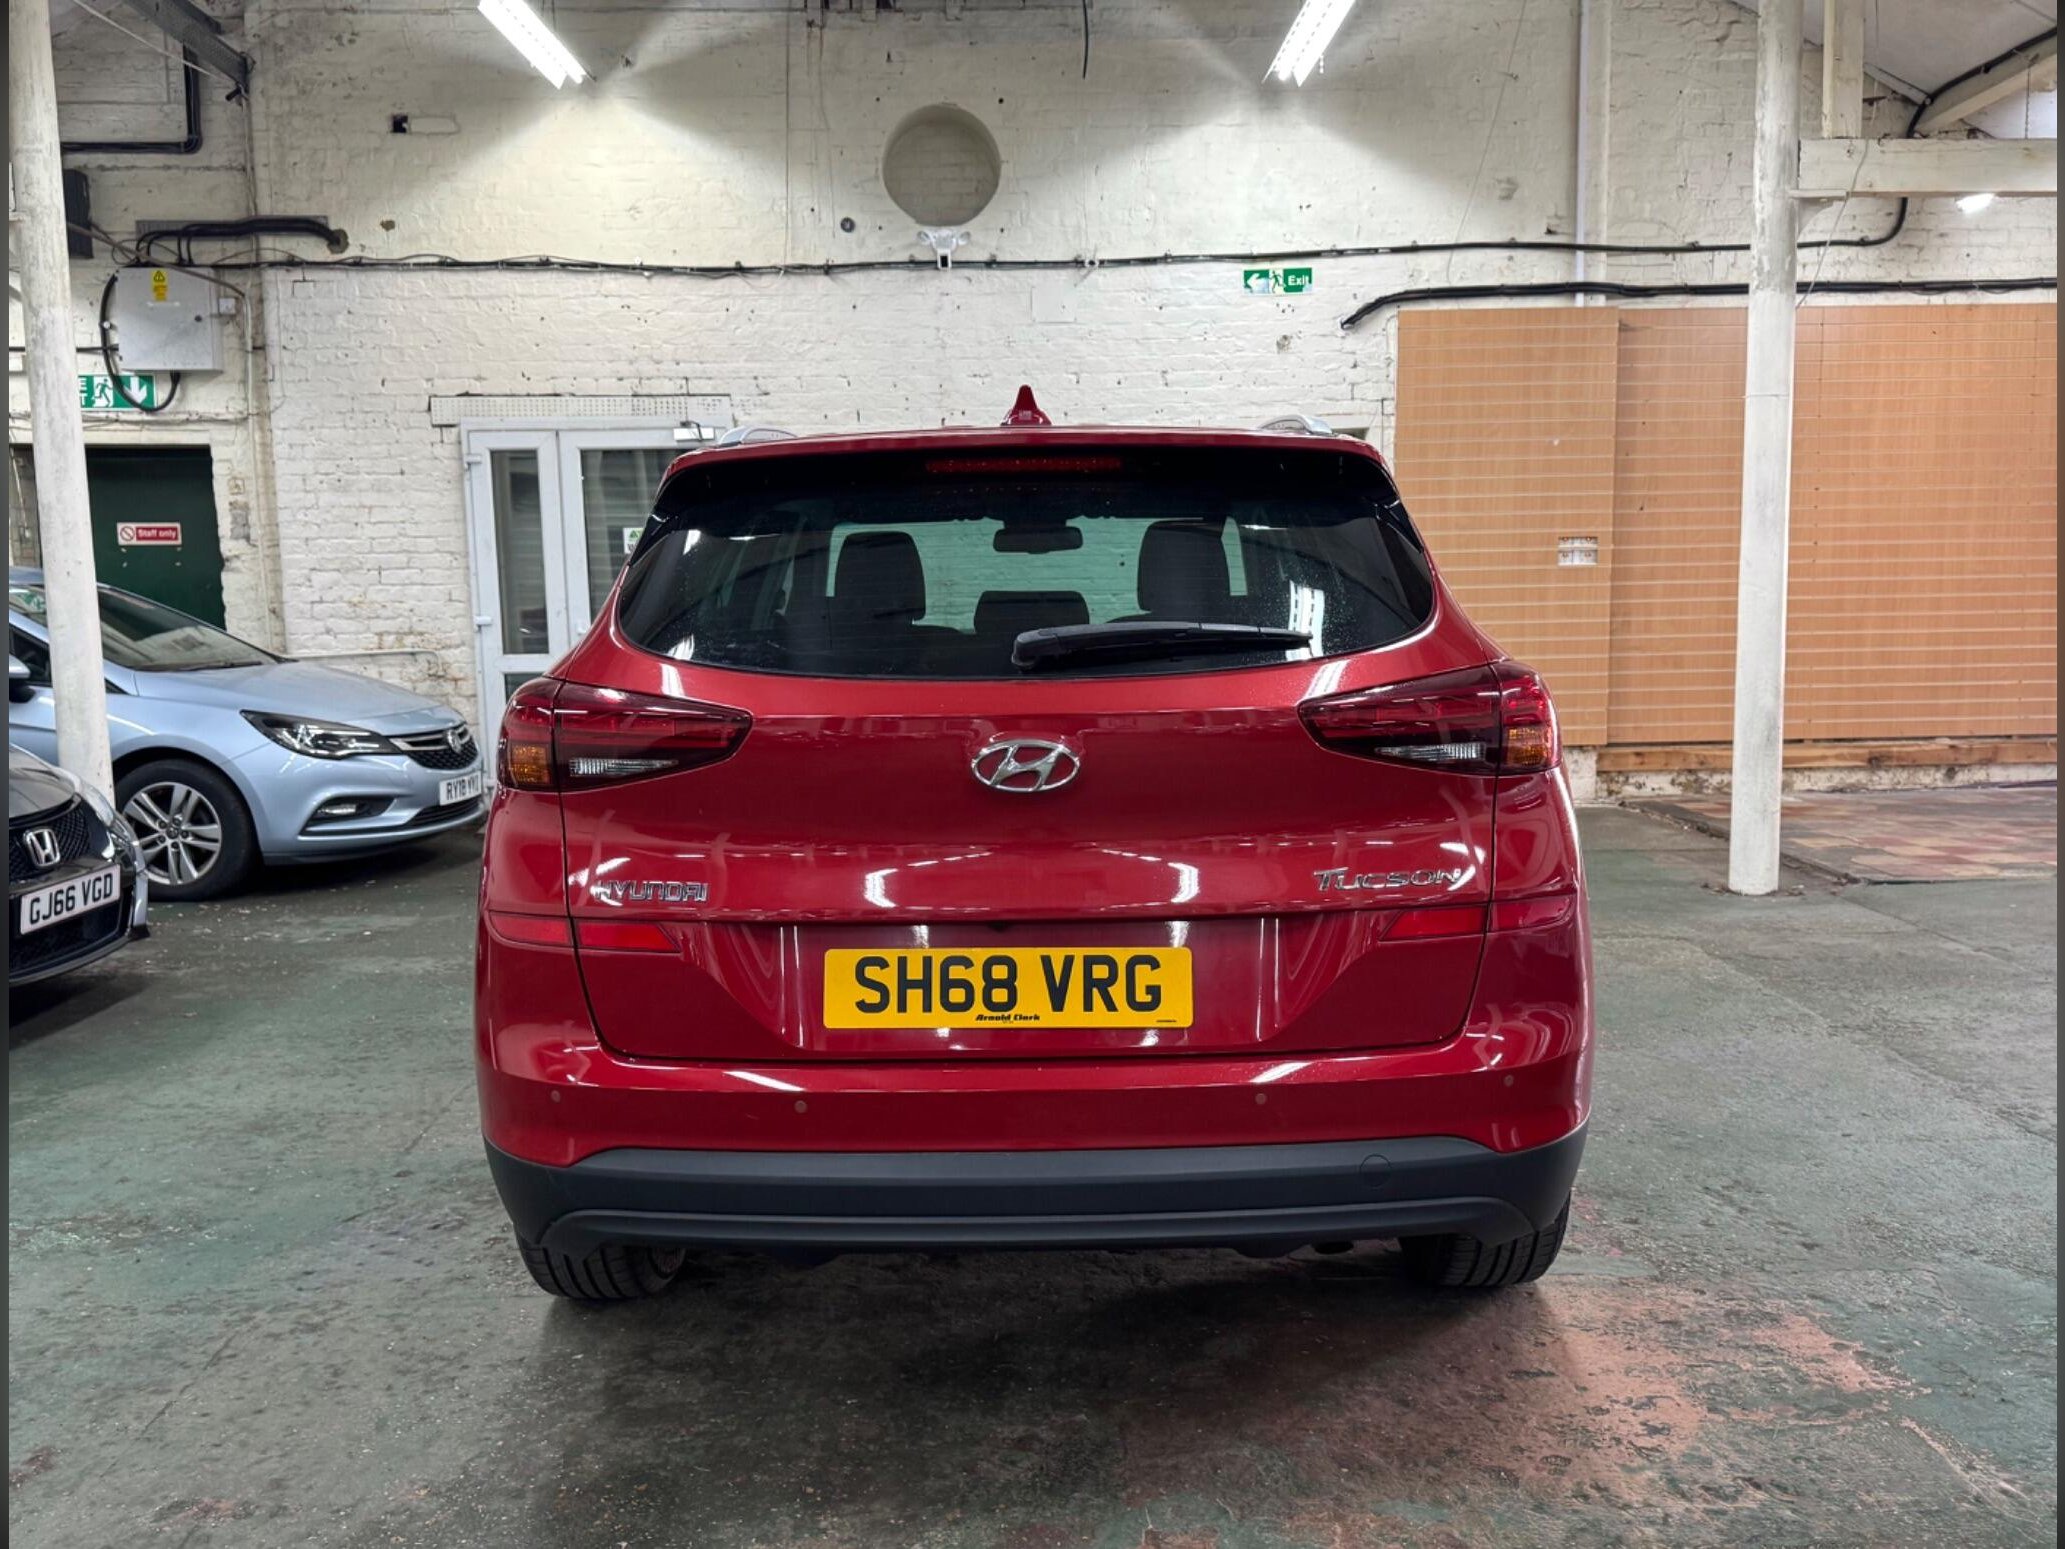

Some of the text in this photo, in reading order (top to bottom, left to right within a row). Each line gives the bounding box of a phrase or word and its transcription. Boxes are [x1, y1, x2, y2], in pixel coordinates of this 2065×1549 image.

[1287, 274, 1309, 286] Exit
[138, 529, 177, 539] Staff only
[446, 778, 467, 801] RY18
[29, 872, 114, 925] GJ66 VGD
[594, 878, 709, 902] HYUNDAI
[855, 954, 1162, 1014] SH68 VRG
[975, 1013, 1012, 1022] Arnold
